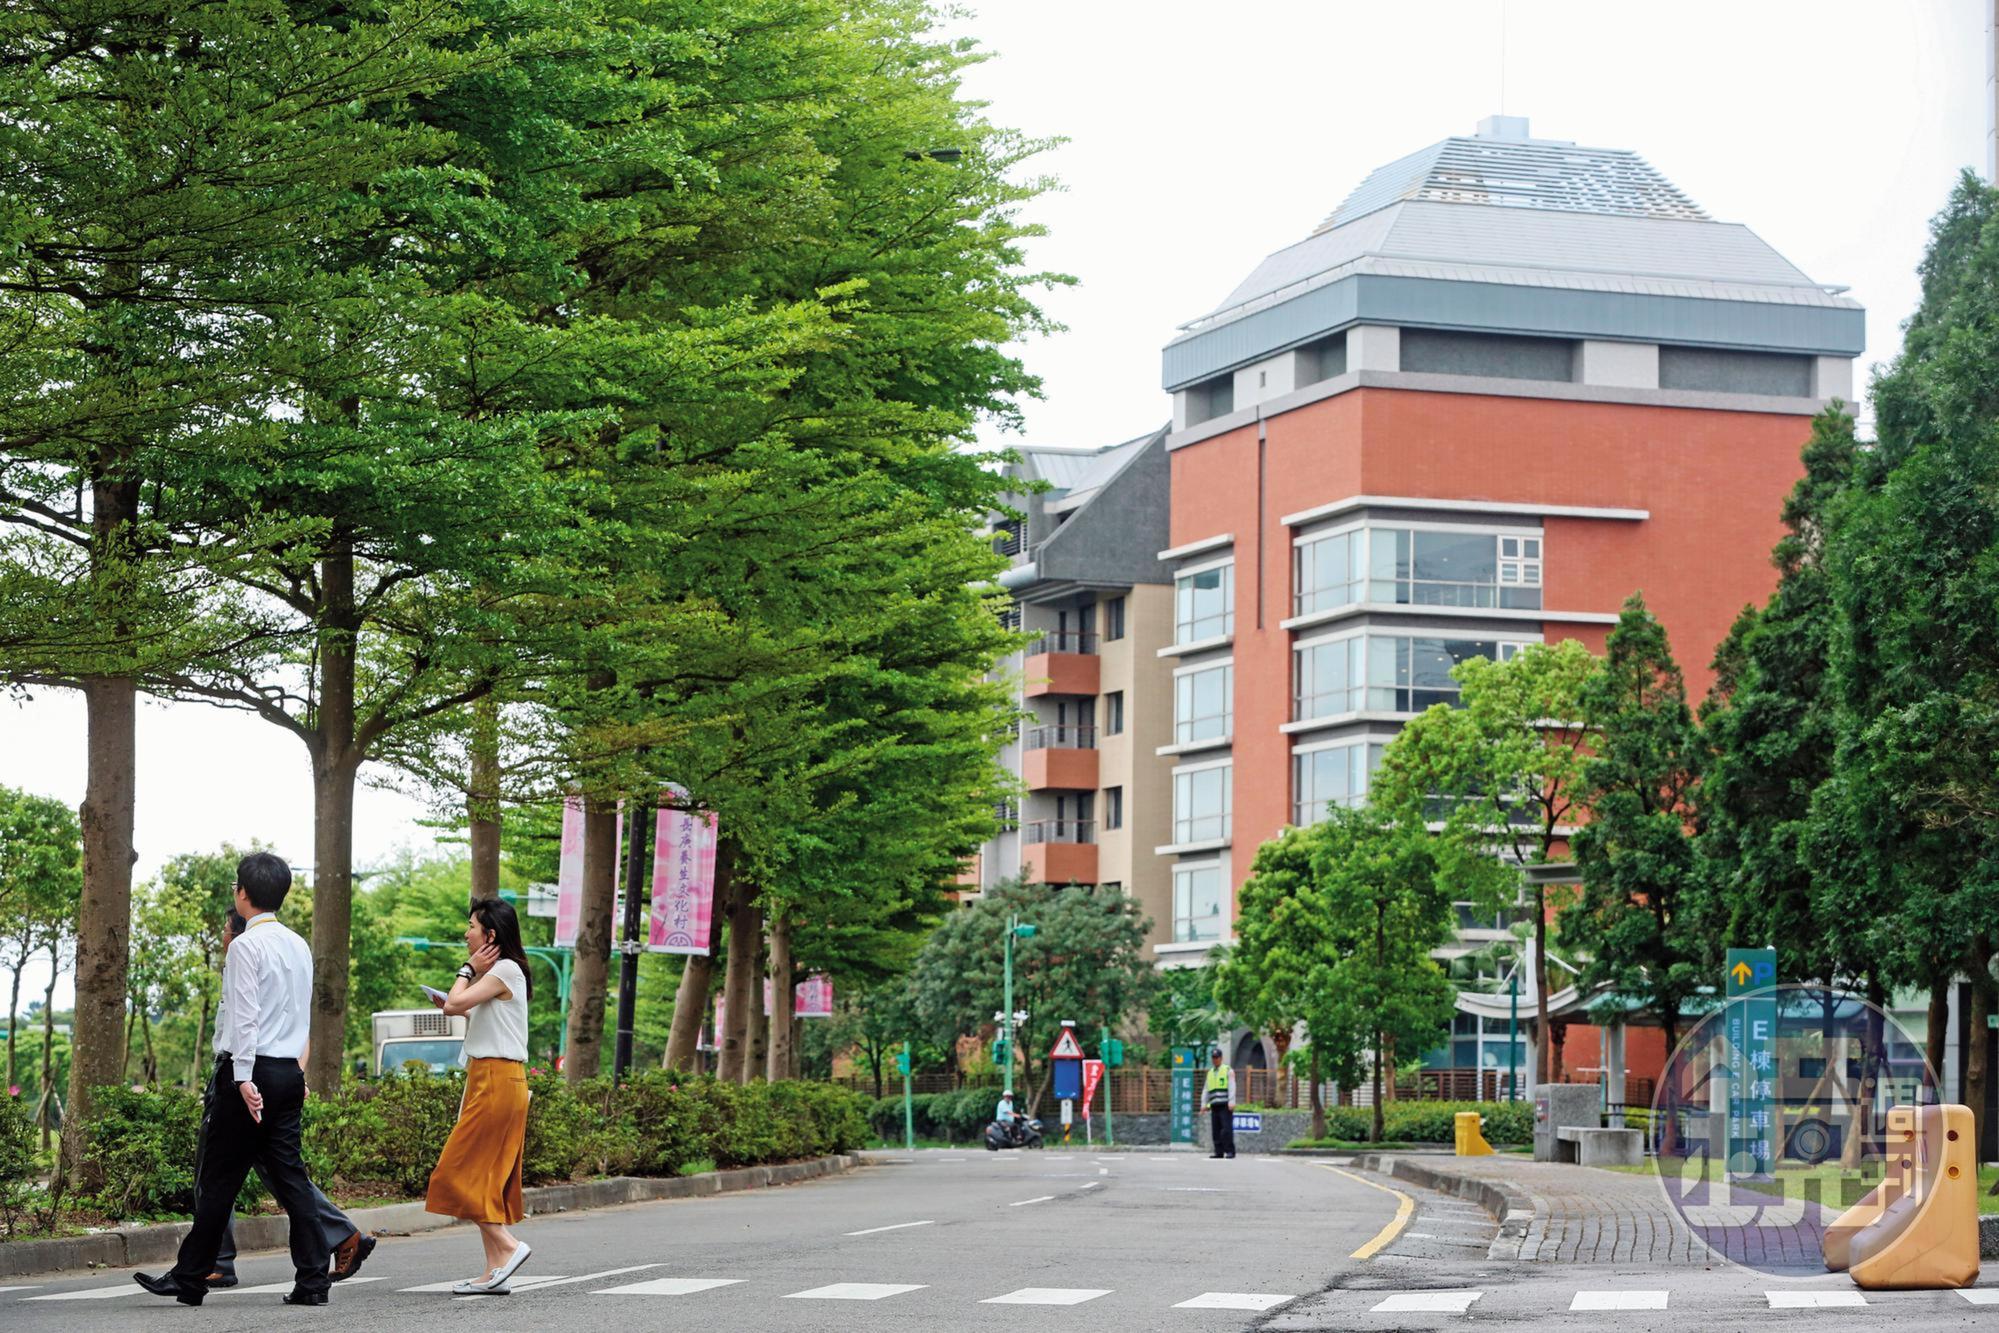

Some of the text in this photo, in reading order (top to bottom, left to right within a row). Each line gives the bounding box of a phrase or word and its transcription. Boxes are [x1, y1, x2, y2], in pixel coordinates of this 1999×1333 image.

[674, 817, 692, 929] 長庚養生文化村
[1754, 962, 1773, 985] P
[1731, 1018, 1741, 1068] BUILDING
[1731, 1082, 1741, 1105] CAR
[1749, 1020, 1771, 1160] E棟停車場
[1731, 1110, 1741, 1138] PARK
